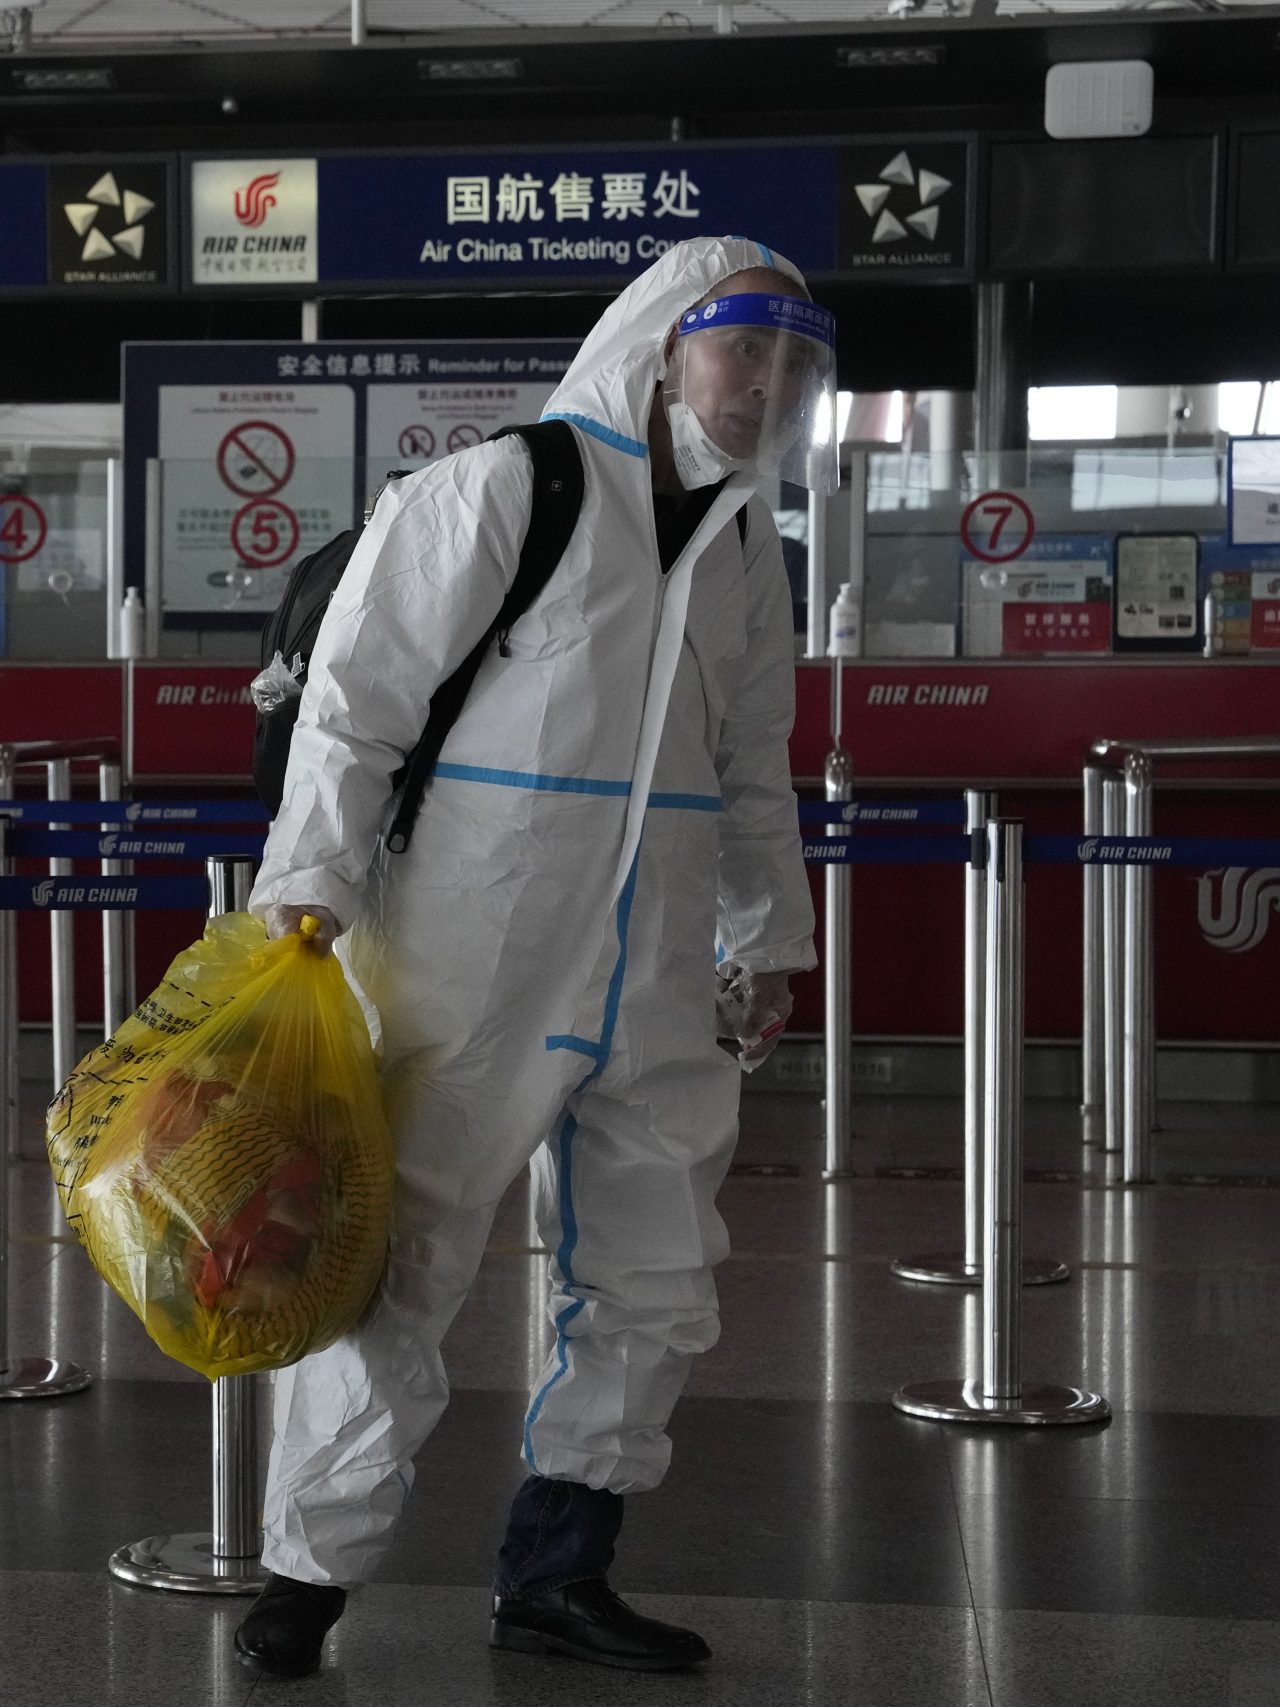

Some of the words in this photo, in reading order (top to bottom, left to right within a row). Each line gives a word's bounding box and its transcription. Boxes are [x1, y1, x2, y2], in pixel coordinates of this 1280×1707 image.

[446, 169, 701, 225] 国航售票处
[203, 236, 238, 253] AIR
[243, 235, 306, 253] CHINA
[420, 240, 451, 262] Air
[457, 238, 523, 262] China
[528, 236, 630, 264] Ticketing
[852, 254, 886, 266] STAR
[889, 252, 952, 265] ALLIANCE
[64, 271, 96, 283] STAR
[97, 270, 156, 282] ALLIANCE
[277, 354, 420, 376] 安全信息提示
[428, 358, 500, 373] Reminder
[503, 358, 524, 373] for
[1024, 628, 1090, 638] CLOSED
[156, 685, 196, 704] AIR
[867, 686, 908, 704] AIR
[914, 685, 988, 704] CHINA
[142, 808, 161, 818] AIR
[163, 808, 197, 818] CHINA
[860, 809, 880, 819] AIR
[882, 809, 918, 819] CHINA
[119, 842, 142, 853] AIR
[144, 842, 185, 853] CHINA
[804, 846, 847, 858] CHINA
[1099, 847, 1124, 858] AIR
[1127, 847, 1172, 859] CHINA
[57, 888, 84, 901] AIR
[88, 888, 138, 902] CHINA
